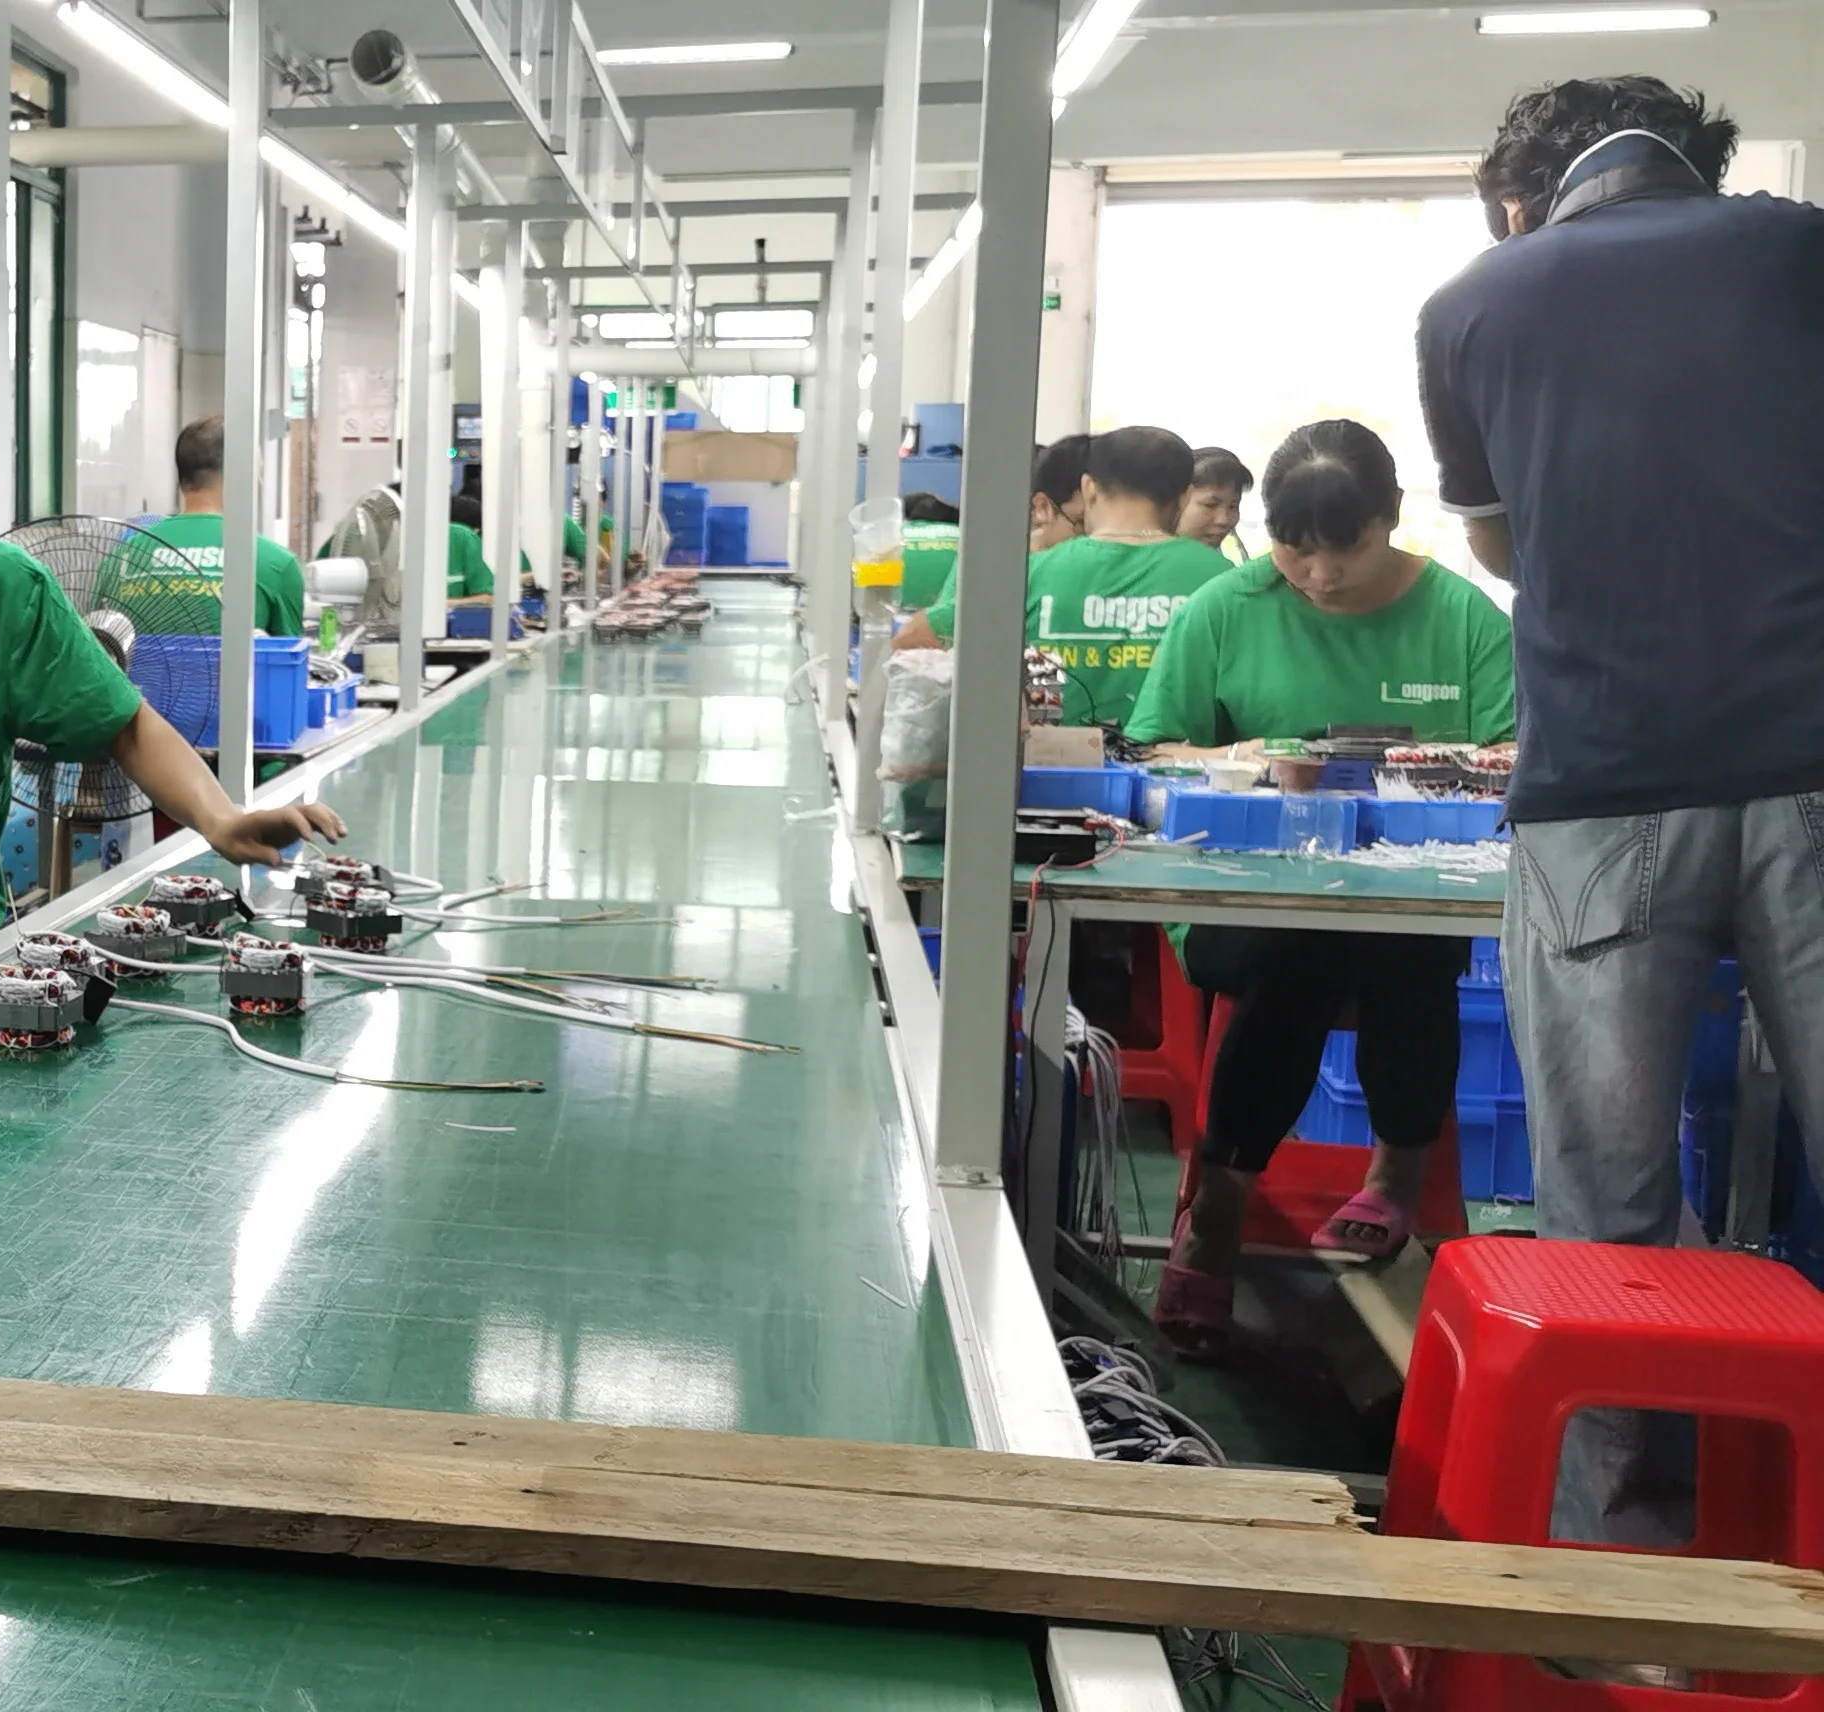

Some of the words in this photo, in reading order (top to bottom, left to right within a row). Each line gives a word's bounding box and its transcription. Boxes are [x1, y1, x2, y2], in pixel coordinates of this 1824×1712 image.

[1085, 645, 1100, 667] &
[1107, 644, 1160, 669] SPE
[1380, 681, 1460, 705] Longson
